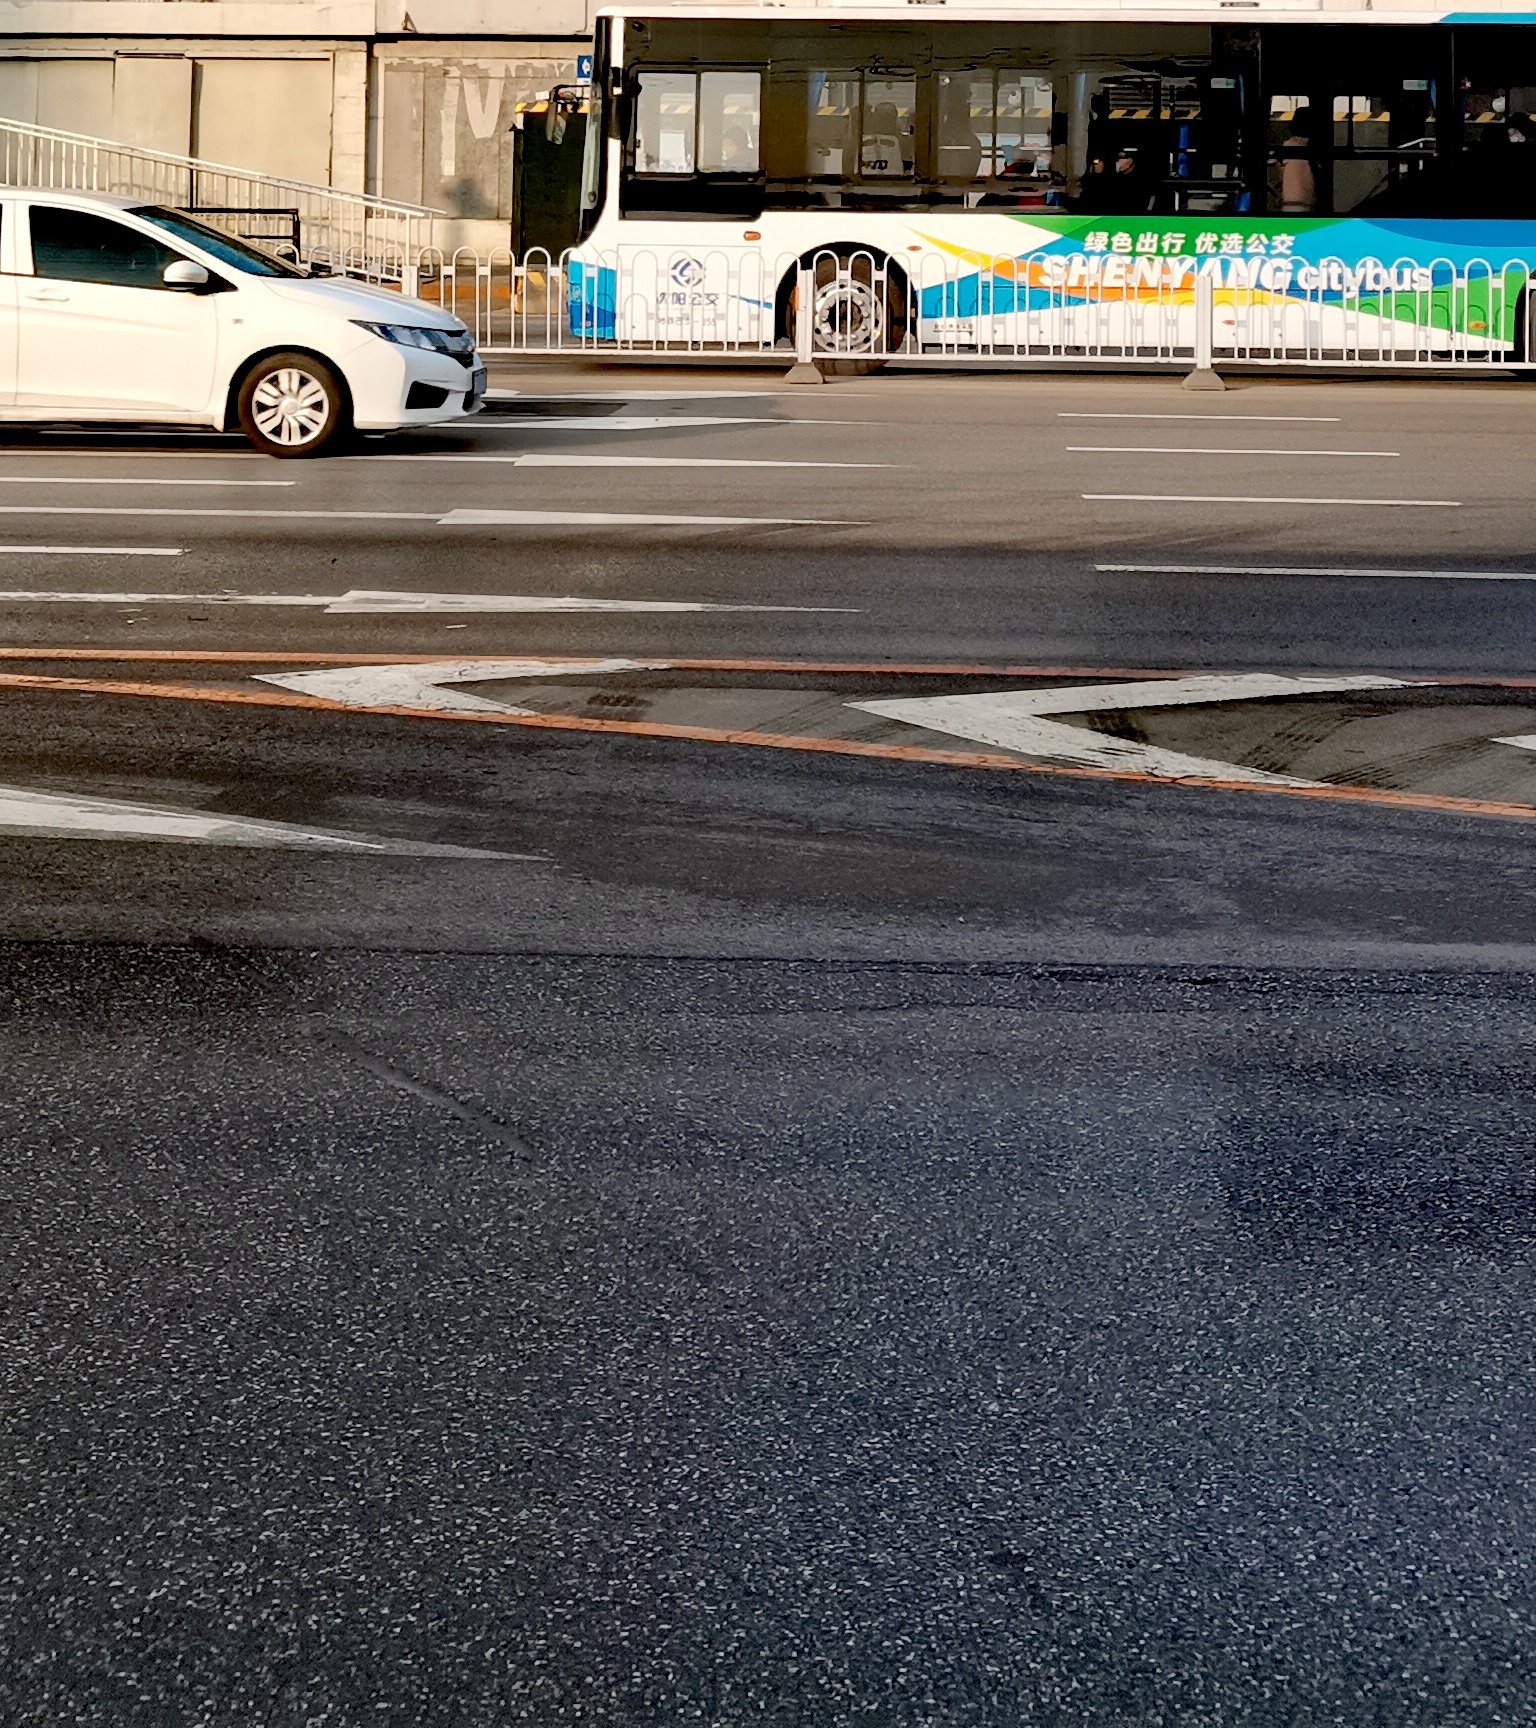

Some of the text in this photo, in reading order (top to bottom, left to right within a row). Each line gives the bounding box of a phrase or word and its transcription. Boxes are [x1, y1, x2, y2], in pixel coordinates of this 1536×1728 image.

[1083, 231, 1296, 255] 绿色出行 优选公交
[1037, 254, 1434, 299] SHENYANG citybus
